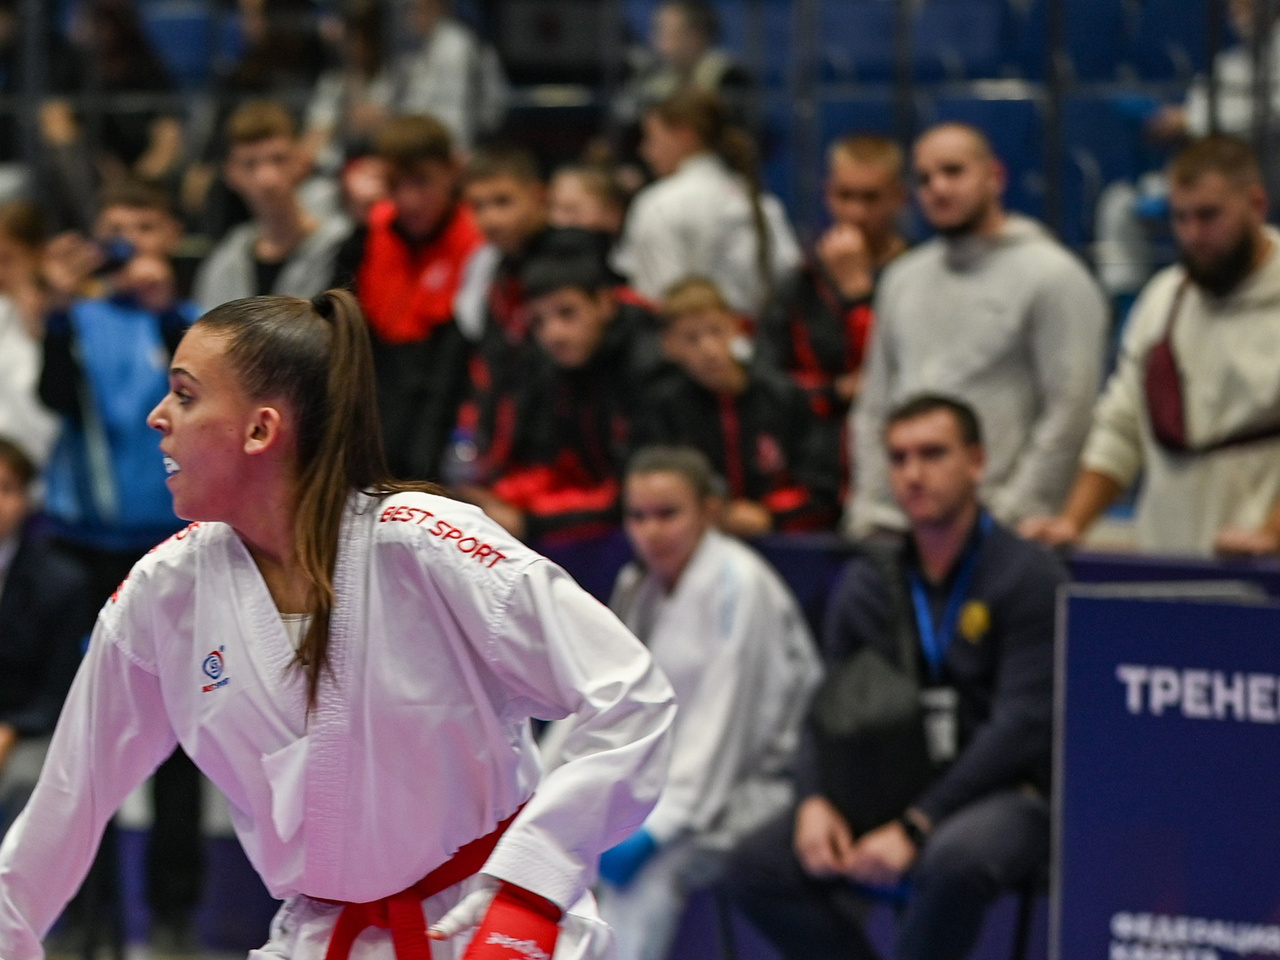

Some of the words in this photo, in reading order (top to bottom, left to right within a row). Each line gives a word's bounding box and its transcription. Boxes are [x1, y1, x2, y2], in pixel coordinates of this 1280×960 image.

[380, 506, 434, 525] BEST
[428, 520, 507, 568] SPORT
[1117, 664, 1280, 724] ТРЕНЕ
